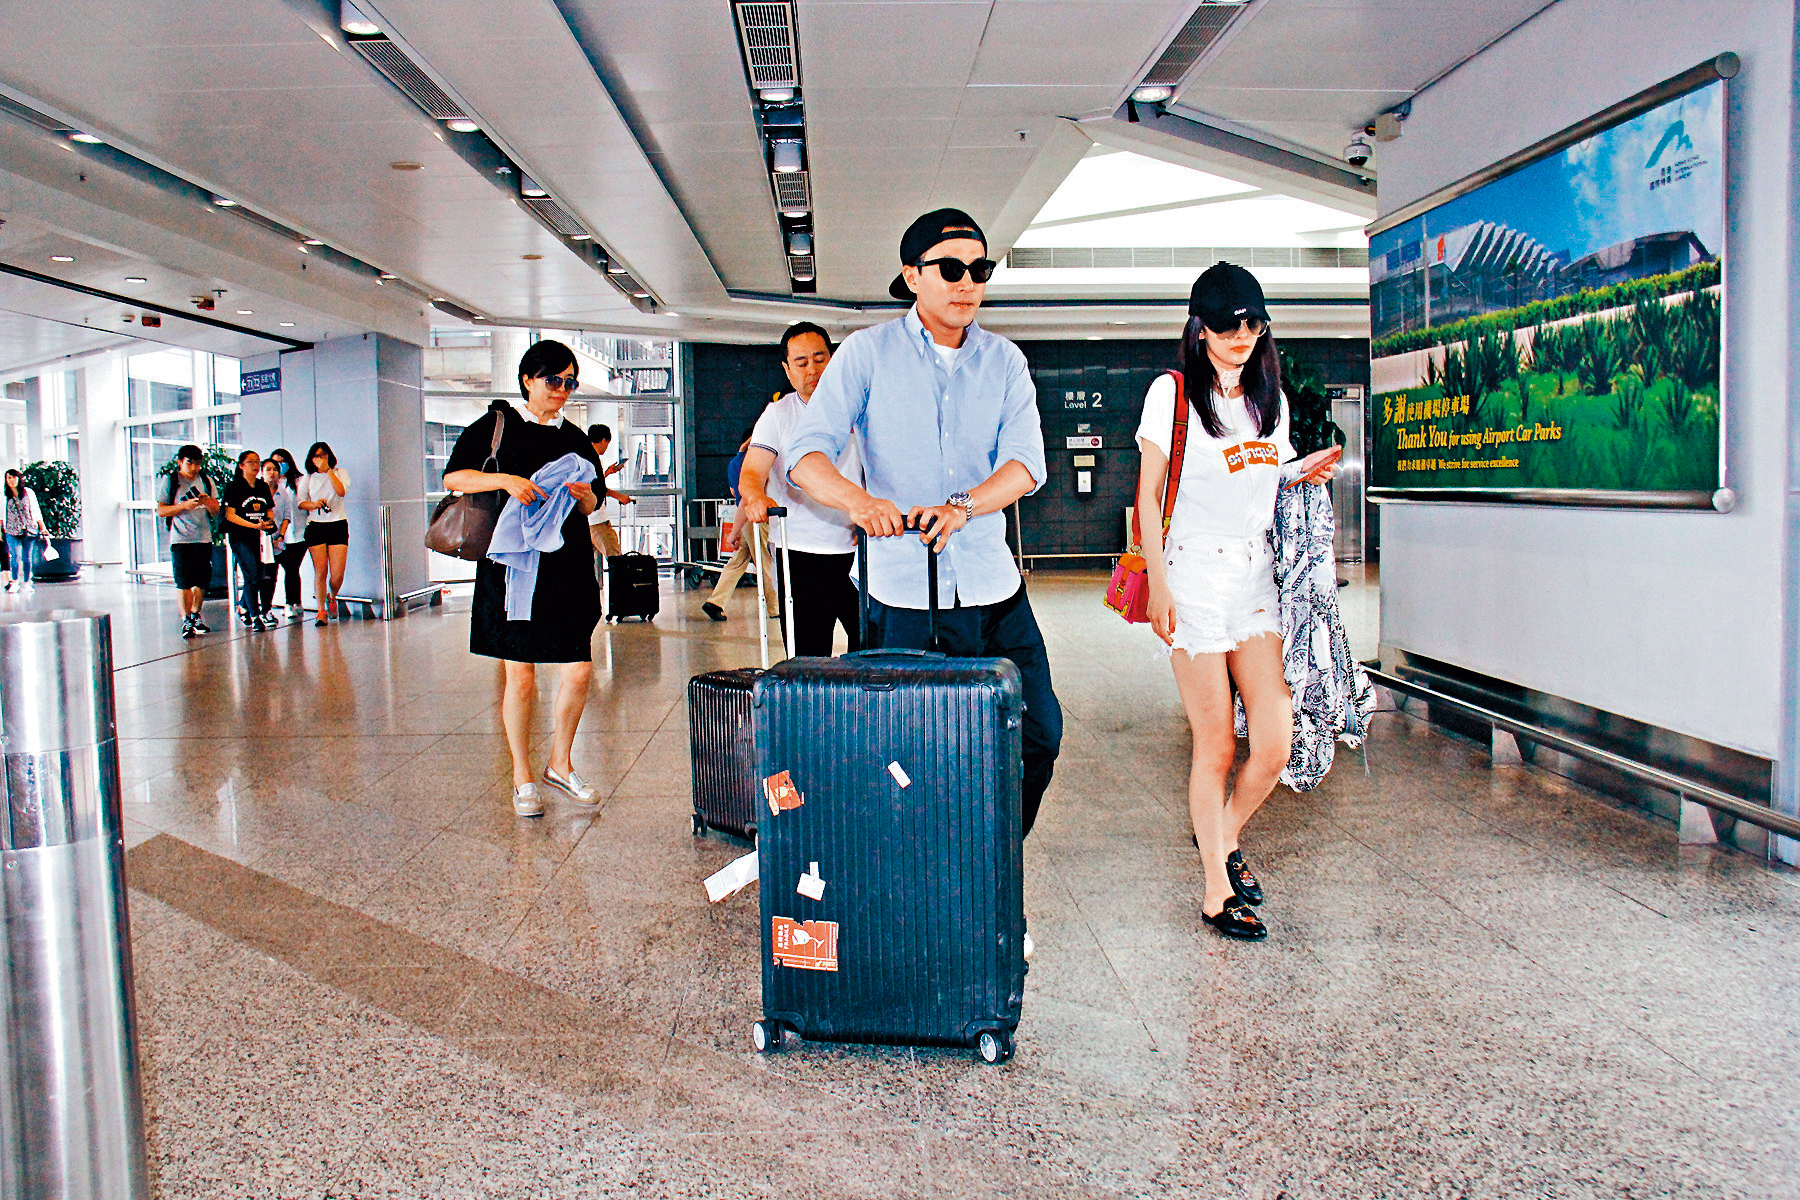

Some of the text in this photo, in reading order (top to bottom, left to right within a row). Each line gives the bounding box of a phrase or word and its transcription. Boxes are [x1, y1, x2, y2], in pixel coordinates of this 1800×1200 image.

[1064, 392, 1103, 409] Level 2
[1397, 421, 1563, 450] Thank You for using Airport Car Parks
[1438, 456, 1520, 470] We strive for service excellence
